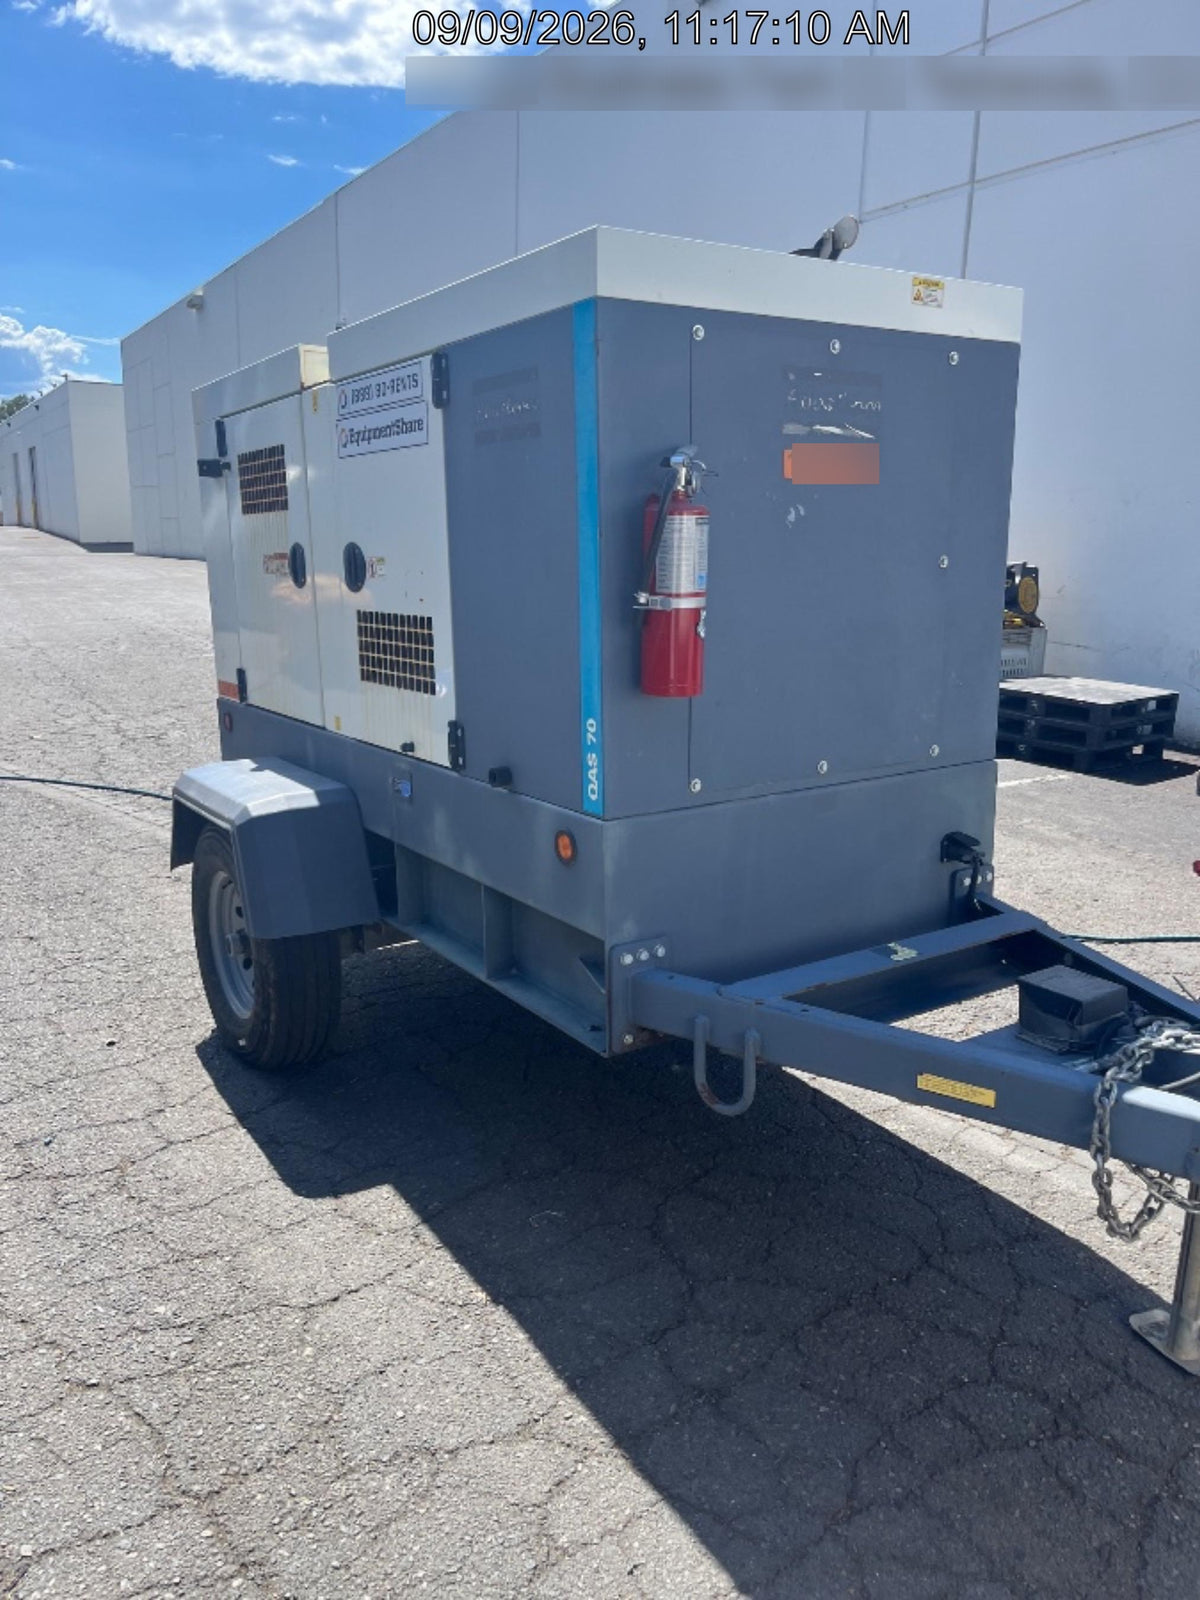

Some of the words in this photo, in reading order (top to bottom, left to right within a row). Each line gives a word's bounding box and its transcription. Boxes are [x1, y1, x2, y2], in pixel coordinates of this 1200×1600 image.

[349, 417, 424, 447] EquipmentShare
[586, 718, 597, 746] 70
[587, 752, 598, 801] QAS
